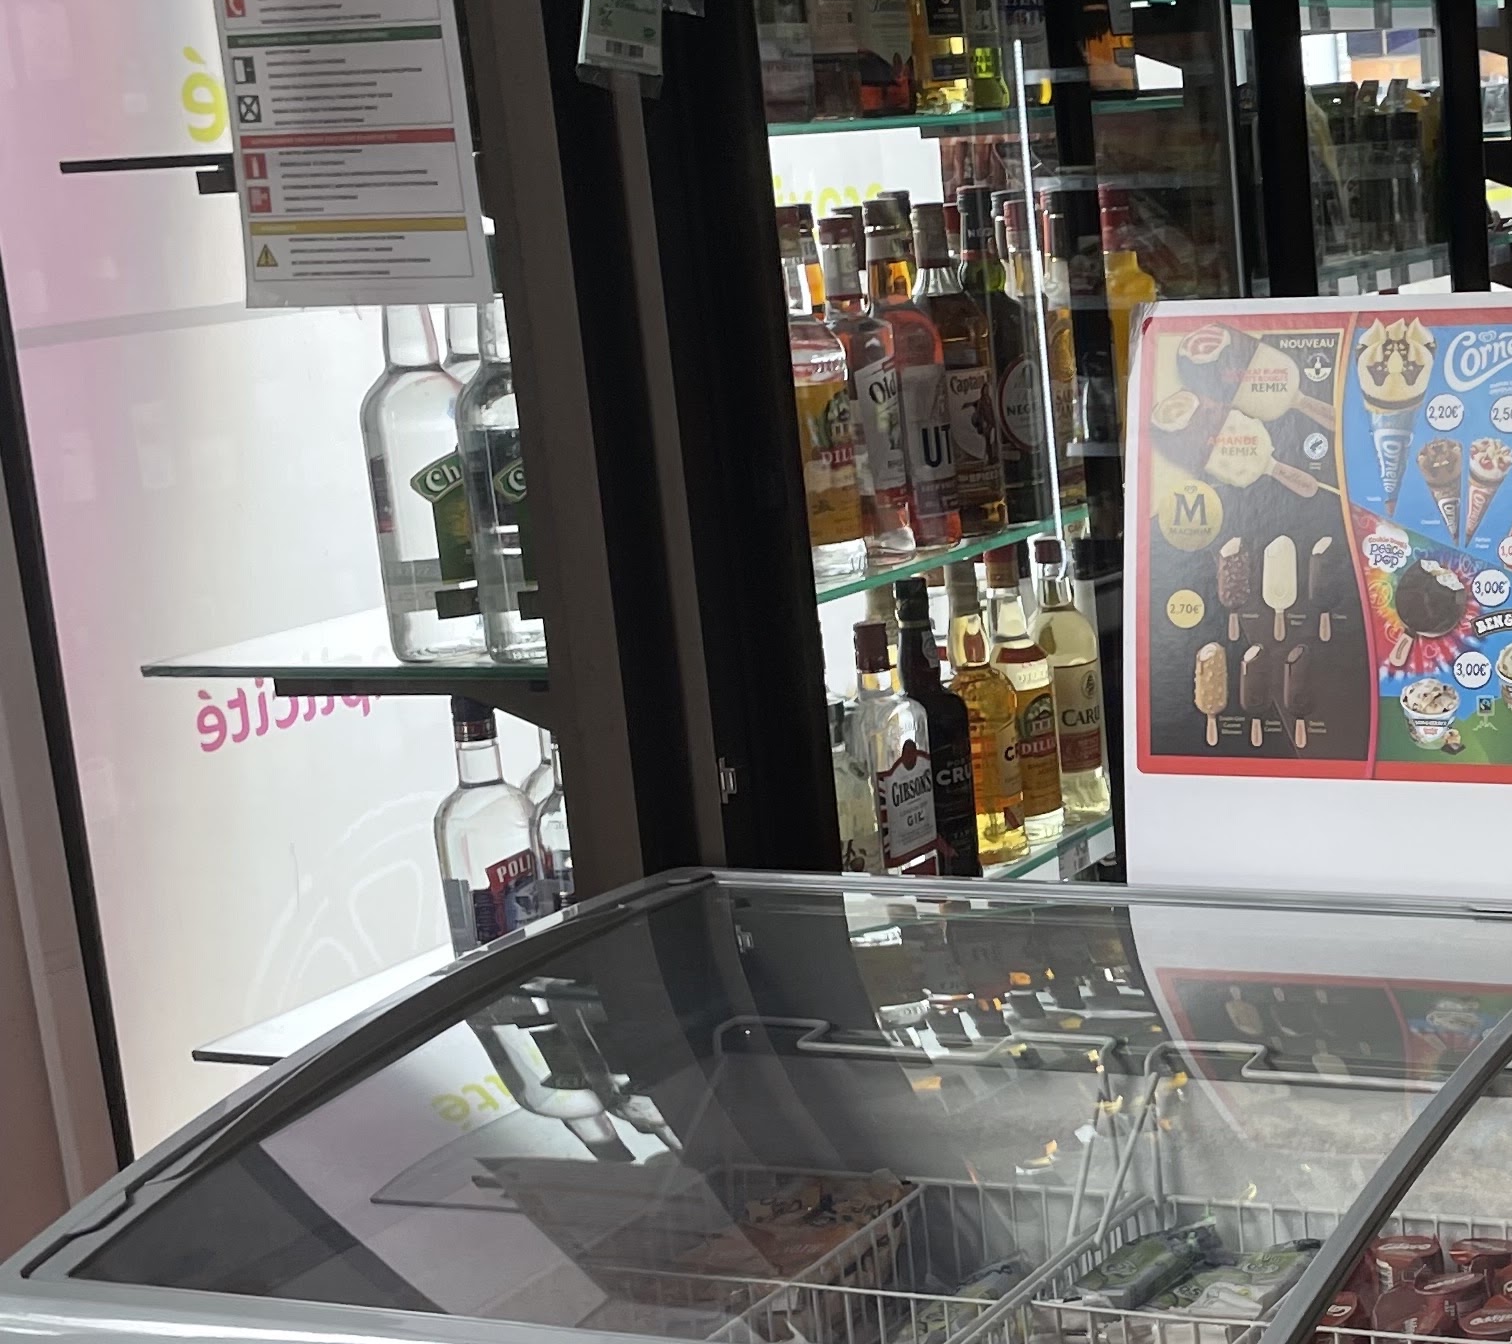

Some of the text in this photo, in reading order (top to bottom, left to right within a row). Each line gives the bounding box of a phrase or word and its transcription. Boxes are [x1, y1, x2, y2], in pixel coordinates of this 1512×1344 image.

[1279, 338, 1336, 350] NOUVEAU
[1251, 382, 1289, 394] REMIX
[1173, 492, 1208, 527] M
